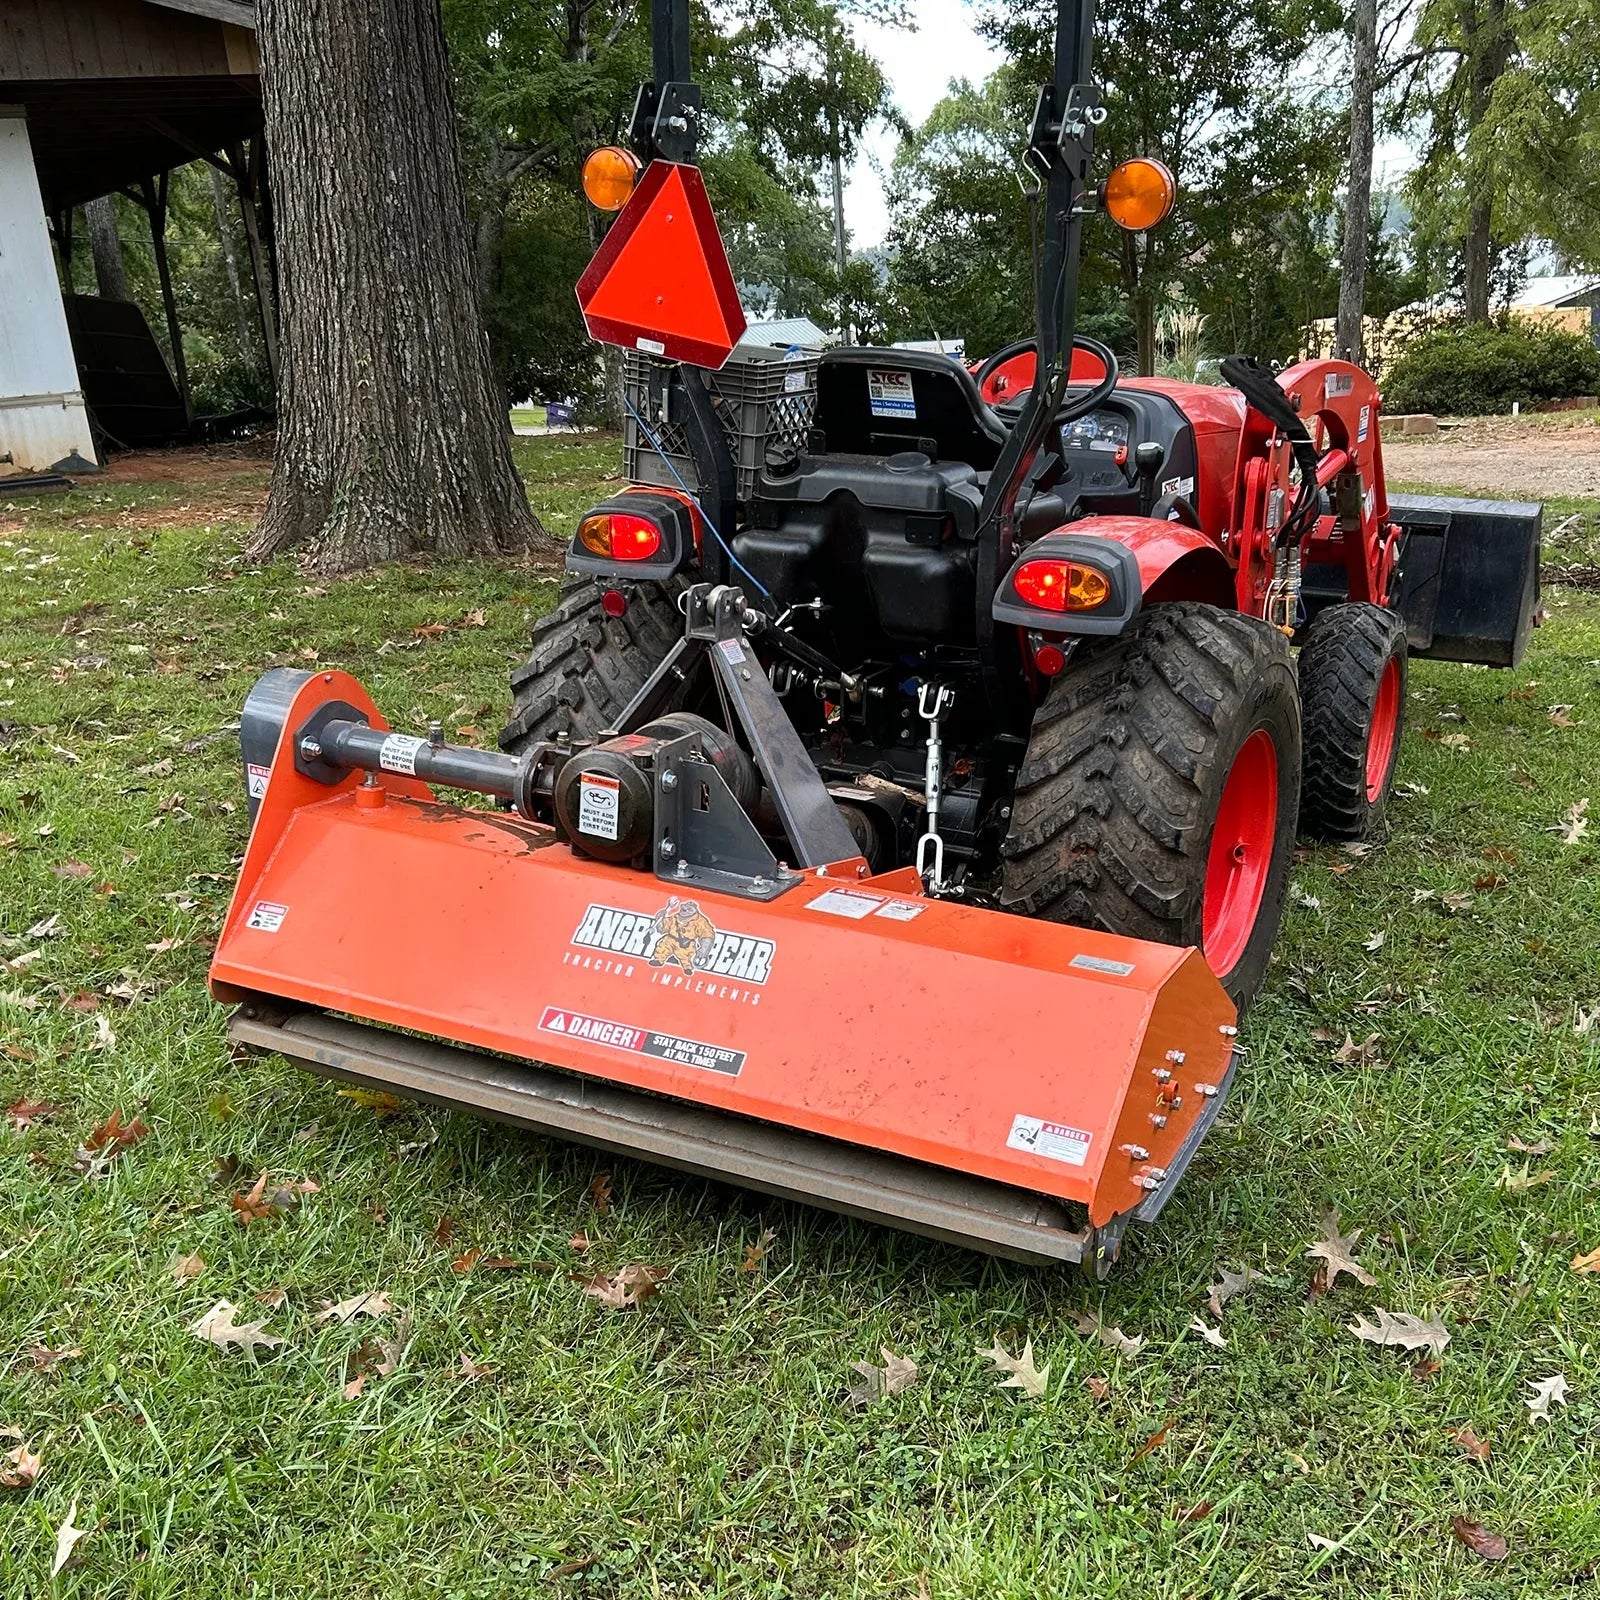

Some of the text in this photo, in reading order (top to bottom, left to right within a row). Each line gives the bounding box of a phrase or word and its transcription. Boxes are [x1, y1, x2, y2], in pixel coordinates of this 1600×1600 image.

[871, 372, 906, 386] STEC
[1164, 479, 1178, 494] STEC
[384, 746, 400, 754] MUST
[392, 755, 413, 764] BEFORE
[583, 808, 615, 820] MUST ADD
[582, 821, 613, 834] FIRST USE
[592, 817, 616, 827] BEFORE
[575, 907, 662, 959] ANGRY
[562, 952, 761, 1006] TRACTOR IMPLEMENTS
[567, 1017, 642, 1048] DANGER!
[652, 1035, 737, 1063] STAY BACK 150 FEET
[662, 1048, 717, 1068] AT ALL TIMES
